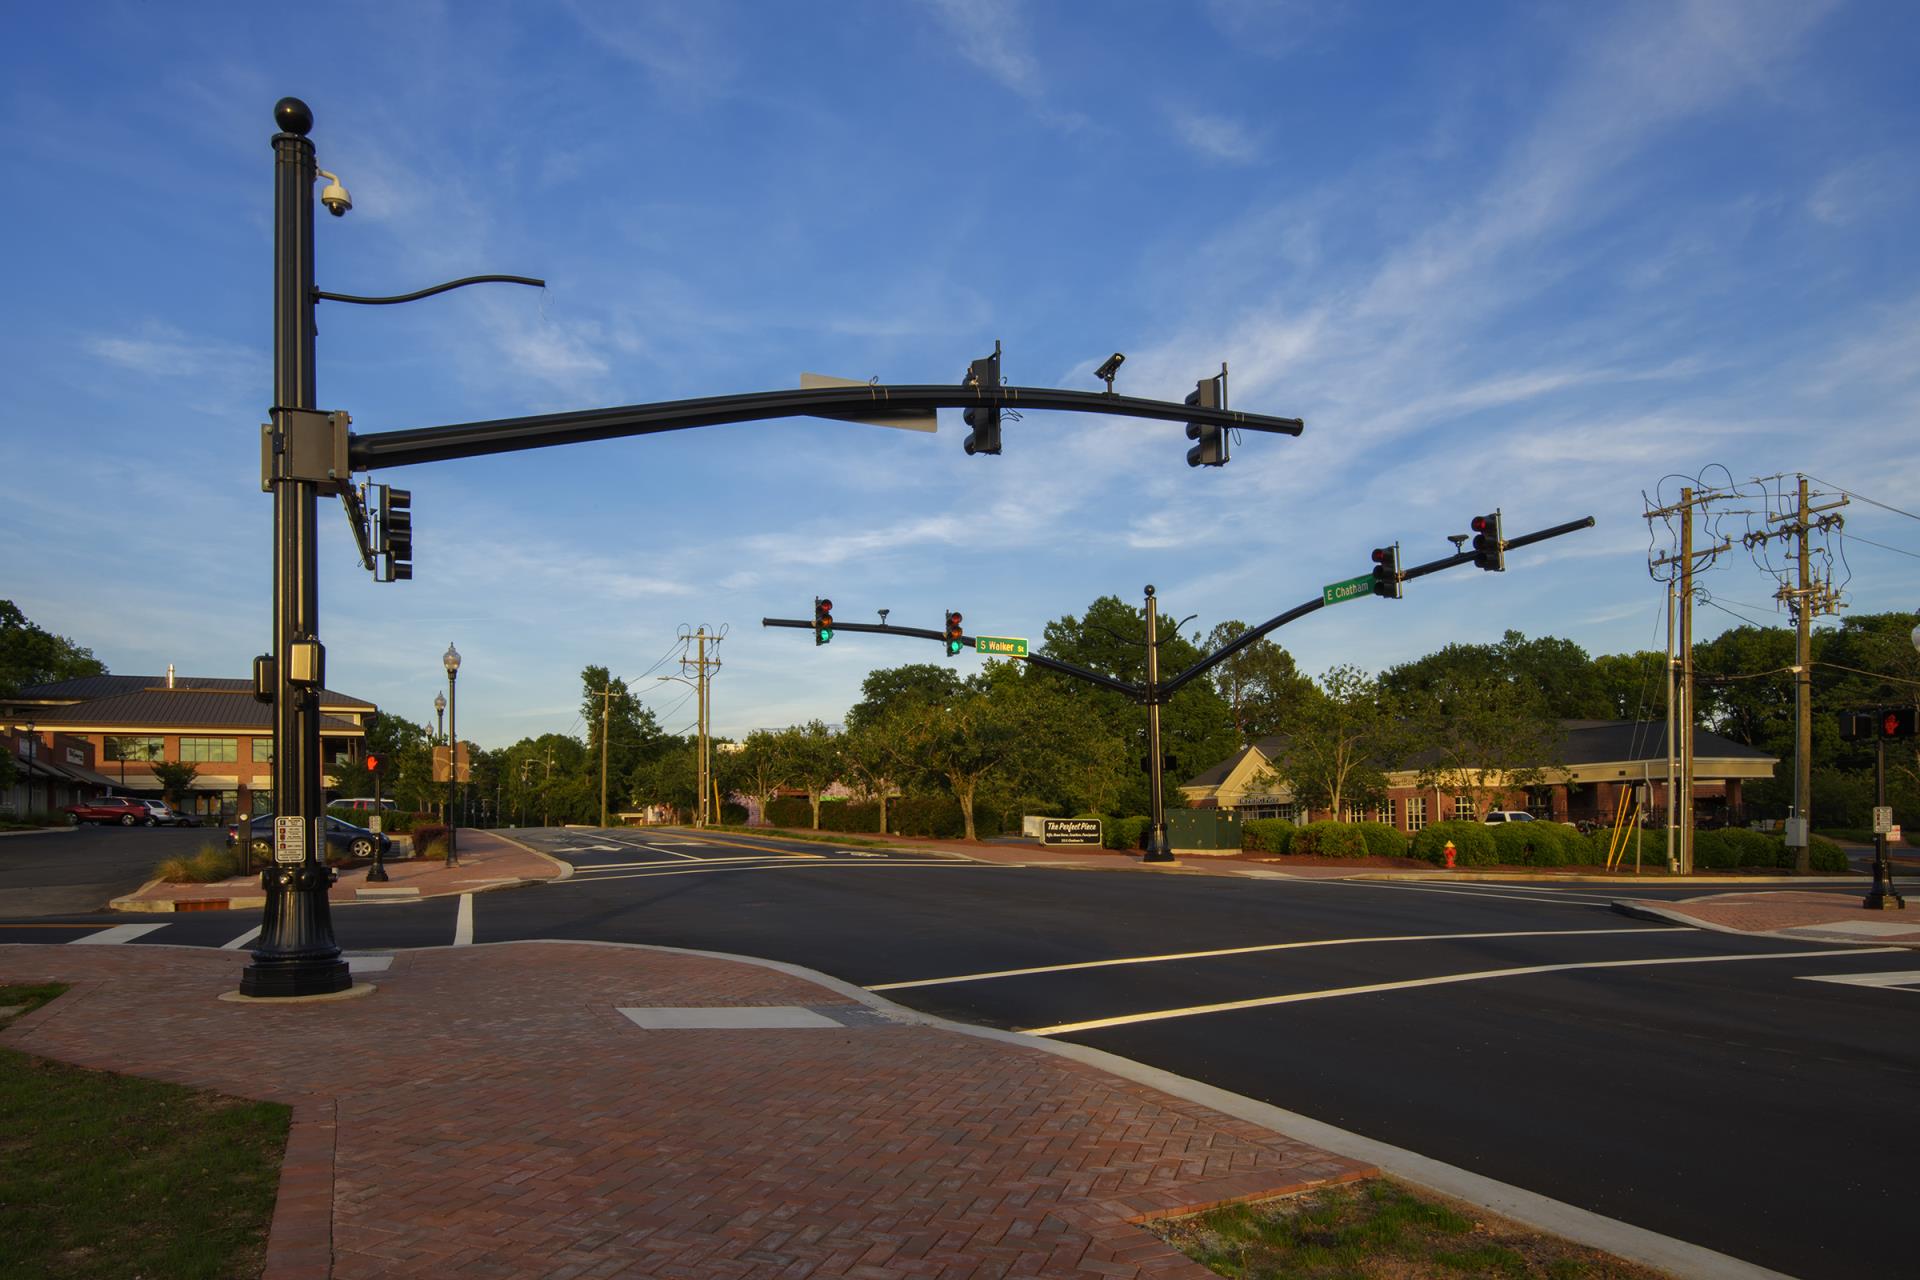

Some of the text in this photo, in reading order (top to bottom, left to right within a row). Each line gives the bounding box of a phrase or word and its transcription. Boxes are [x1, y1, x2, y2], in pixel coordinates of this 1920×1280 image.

[1327, 582, 1369, 601] E Chatham
[980, 640, 986, 650] S
[989, 640, 1014, 652] Walker
[1047, 821, 1097, 833] The Perfect Piece
